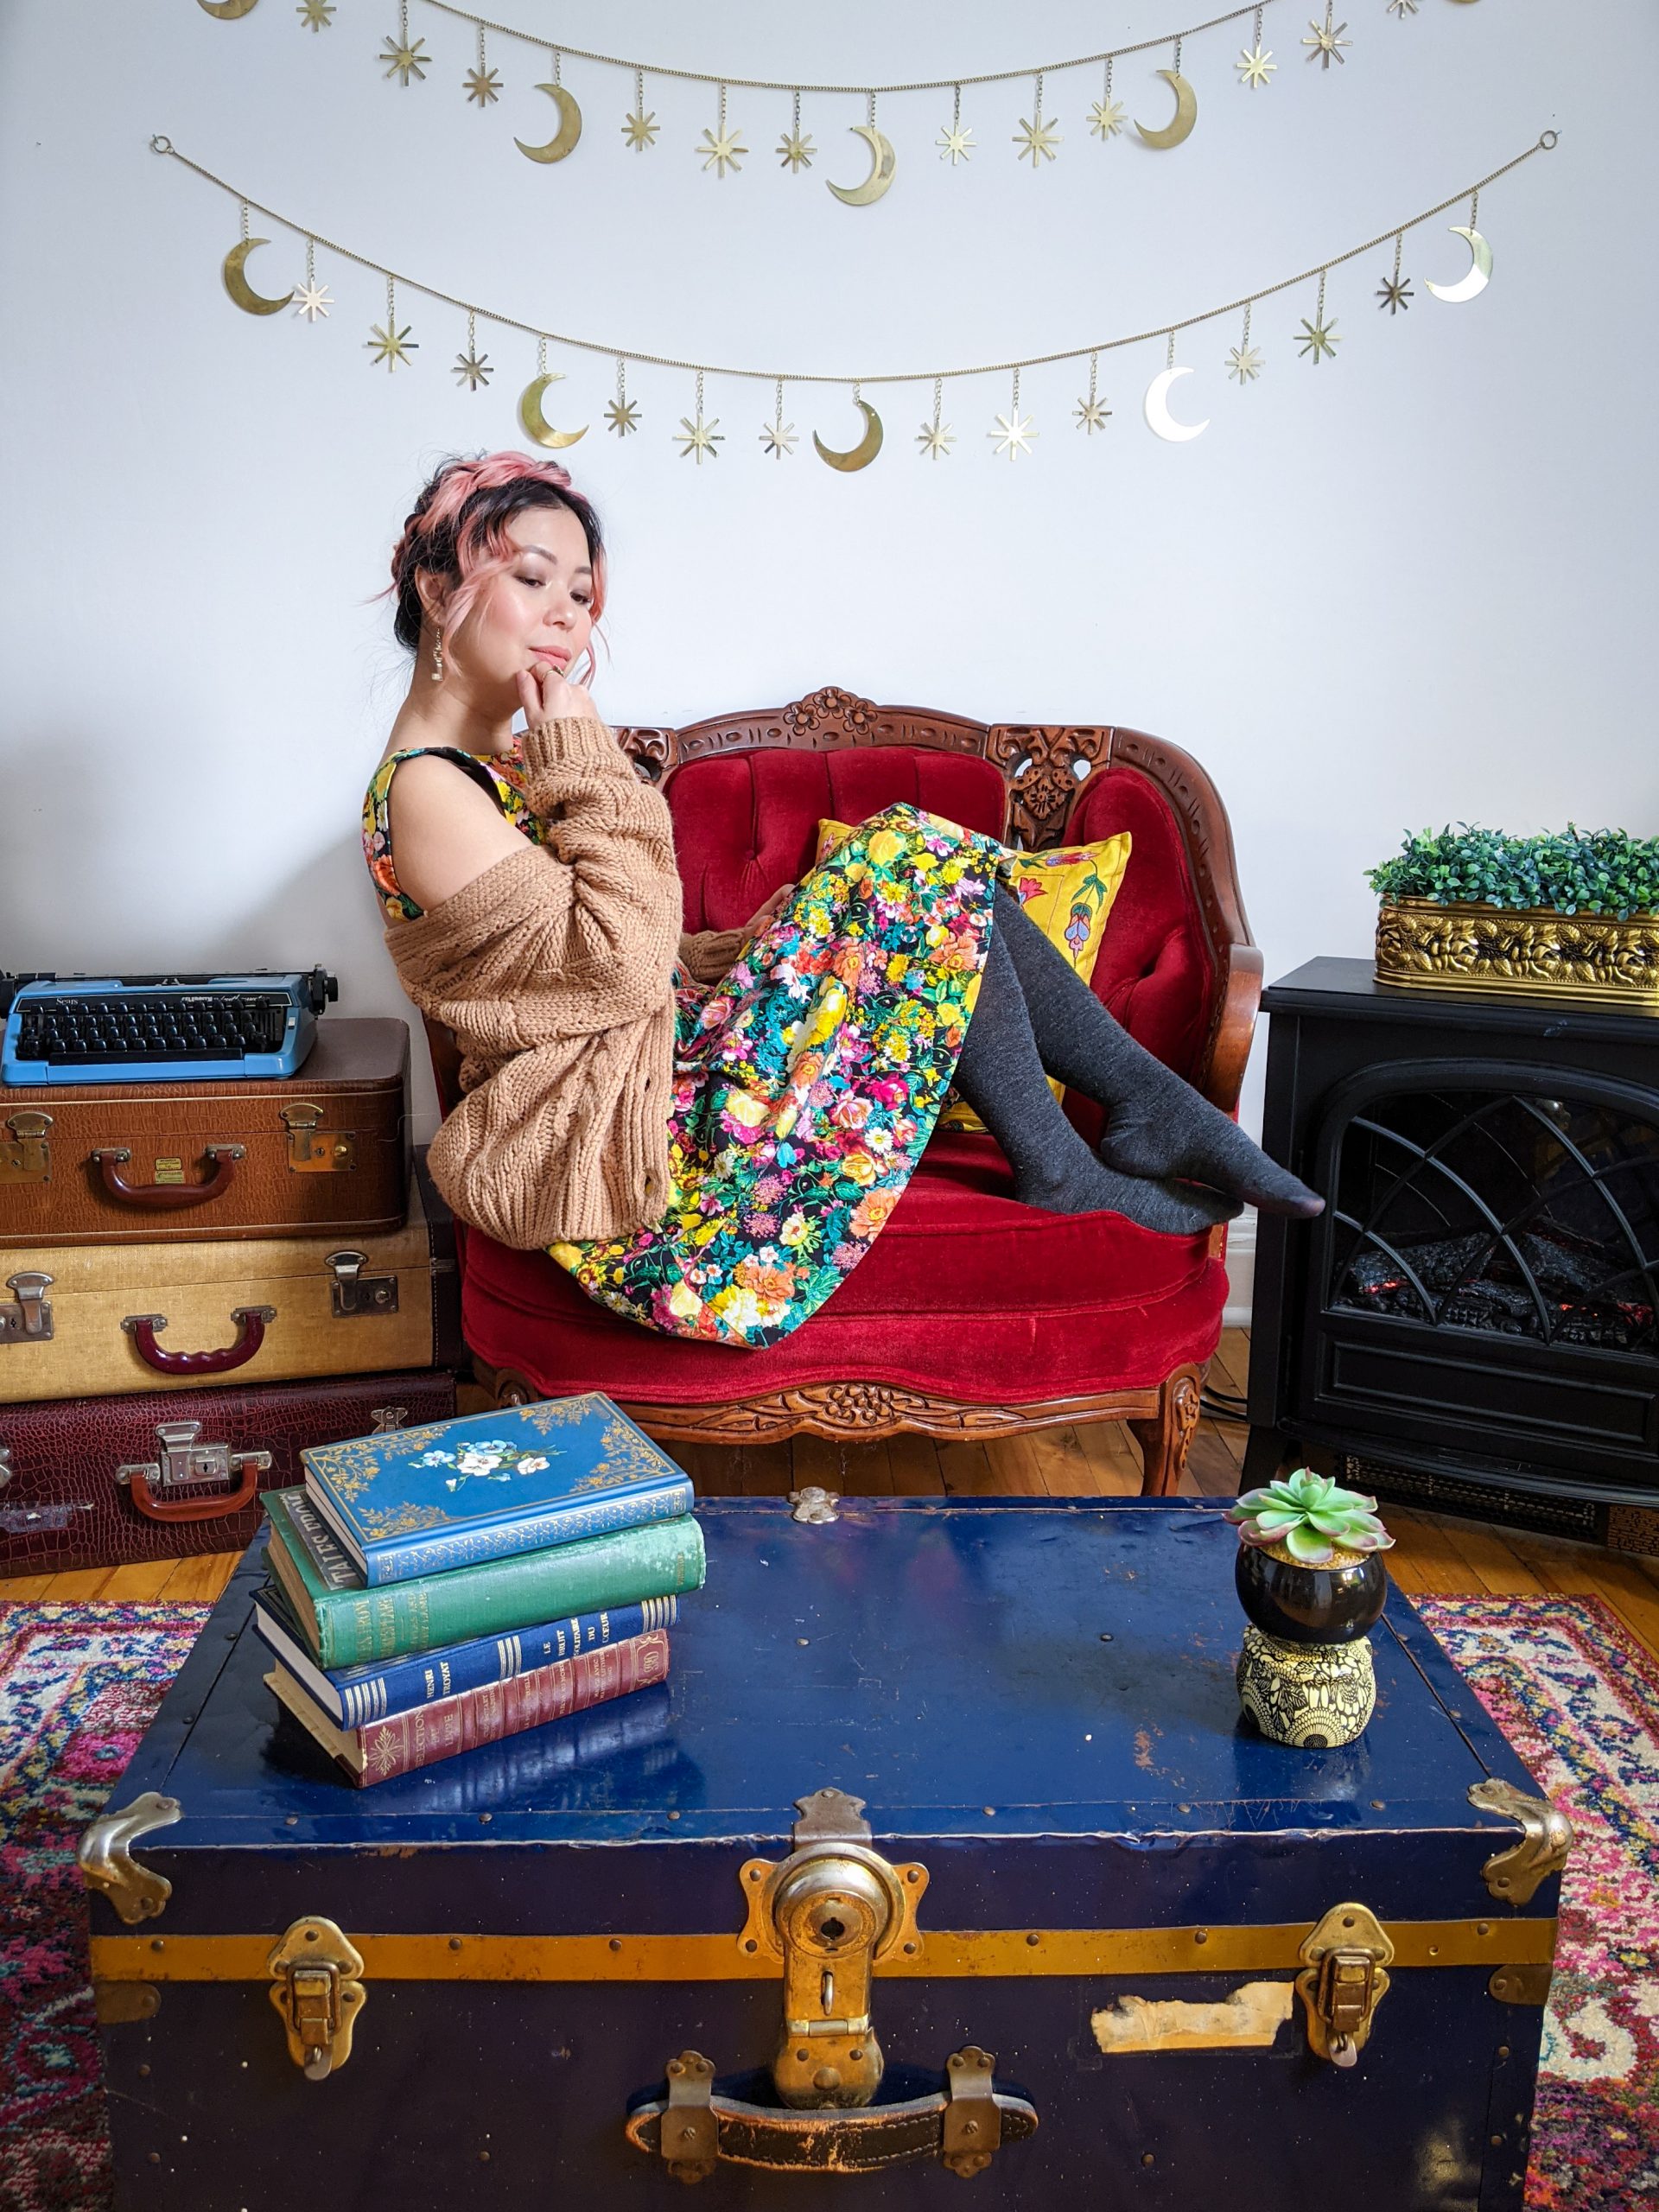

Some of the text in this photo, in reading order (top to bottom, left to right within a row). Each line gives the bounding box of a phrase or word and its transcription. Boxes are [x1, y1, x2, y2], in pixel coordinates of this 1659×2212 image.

[56, 997, 79, 1006] Sears
[287, 1494, 357, 1583] TALES FROM
[543, 1641, 551, 1654] LE
[556, 1630, 567, 1656] BRUIT
[570, 1618, 582, 1657] SOLITAIRE
[587, 1626, 596, 1641] DU
[424, 1669, 435, 1699] HENRI
[440, 1662, 452, 1694] TROYAT
